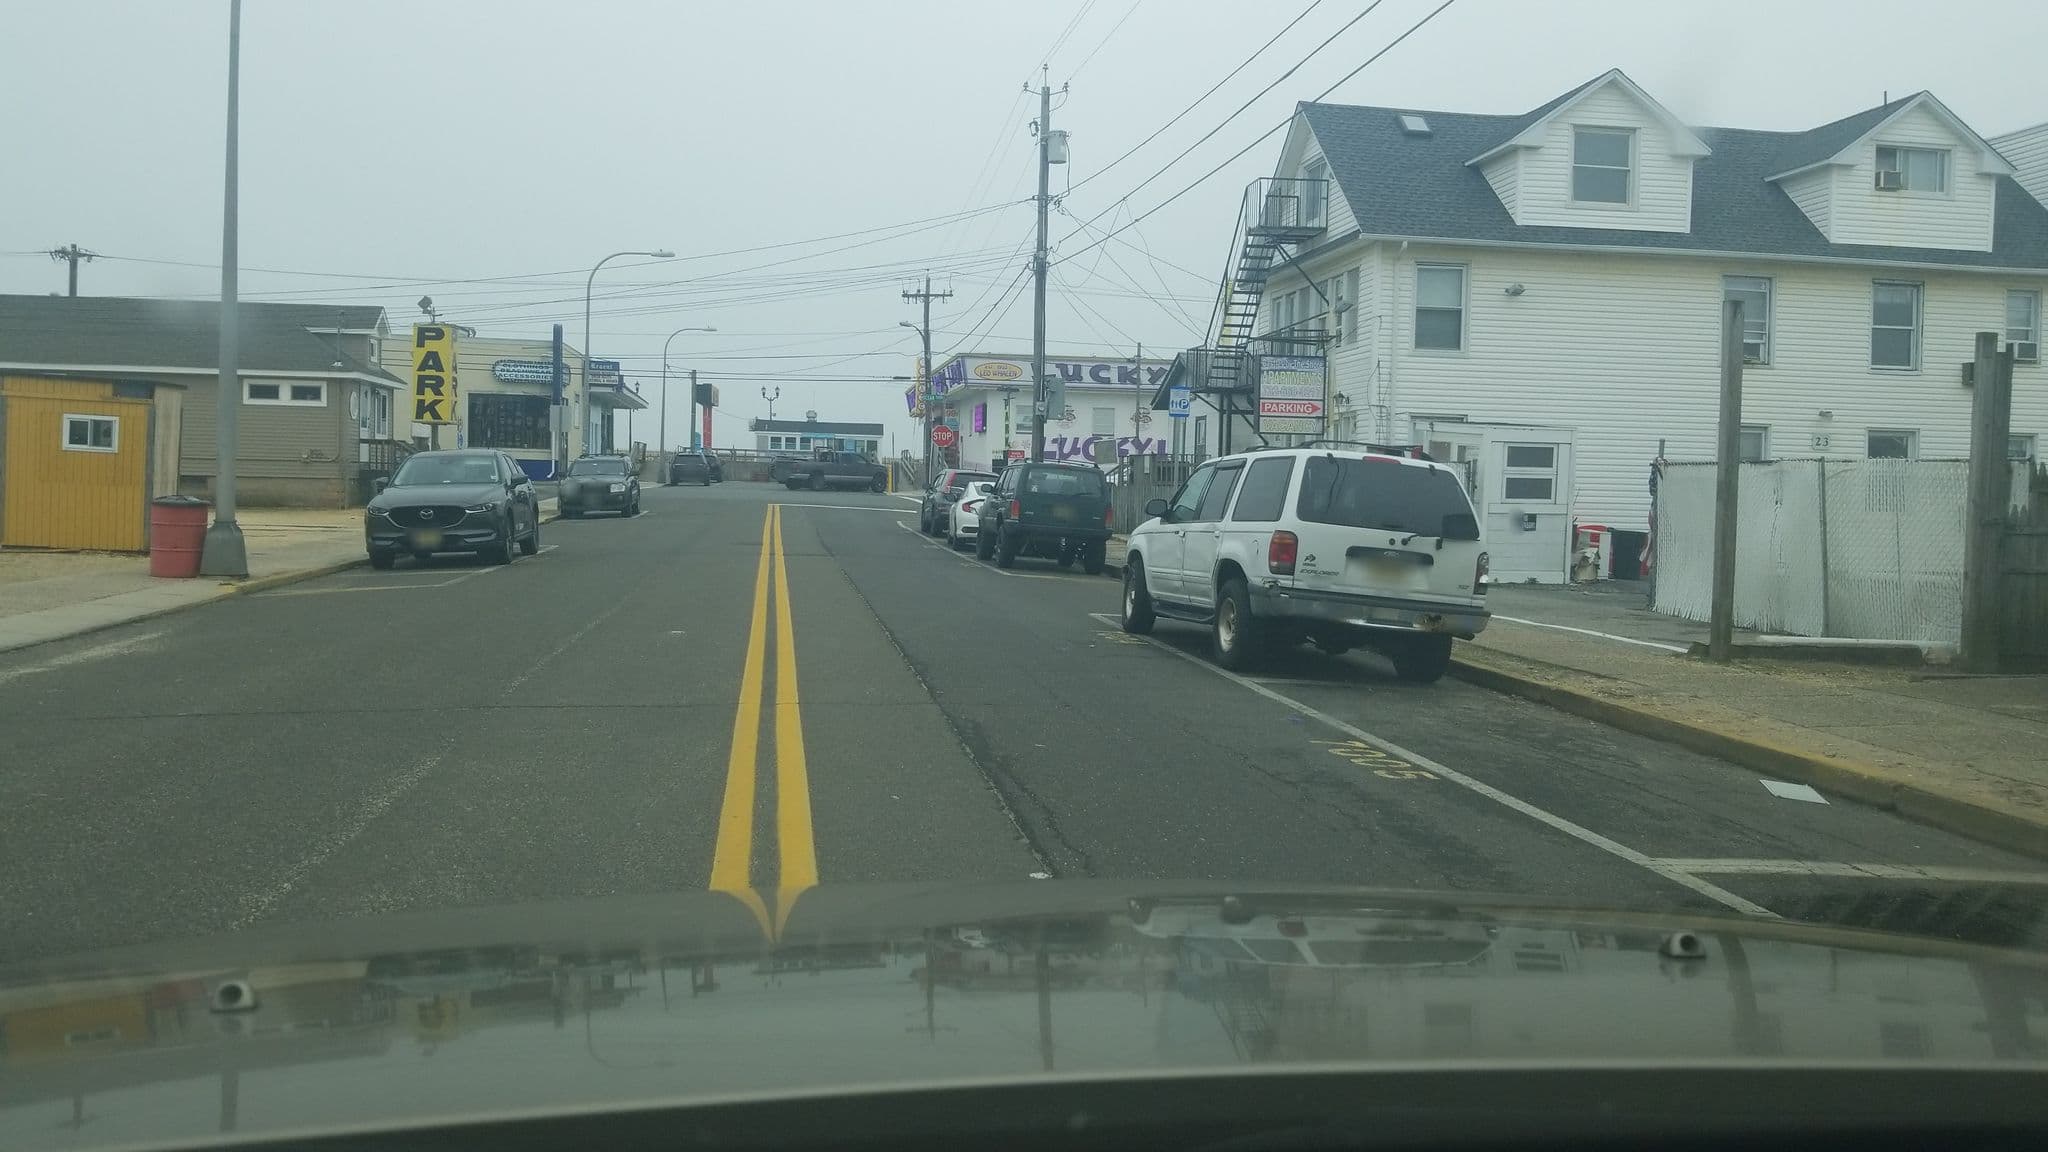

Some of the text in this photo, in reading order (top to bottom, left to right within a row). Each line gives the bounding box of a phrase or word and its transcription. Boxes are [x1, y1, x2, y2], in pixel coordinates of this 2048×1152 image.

[415, 326, 446, 421] PARK
[1264, 403, 1313, 413] PARKING
[933, 431, 952, 441] STOP
[1815, 436, 1829, 447] 23
